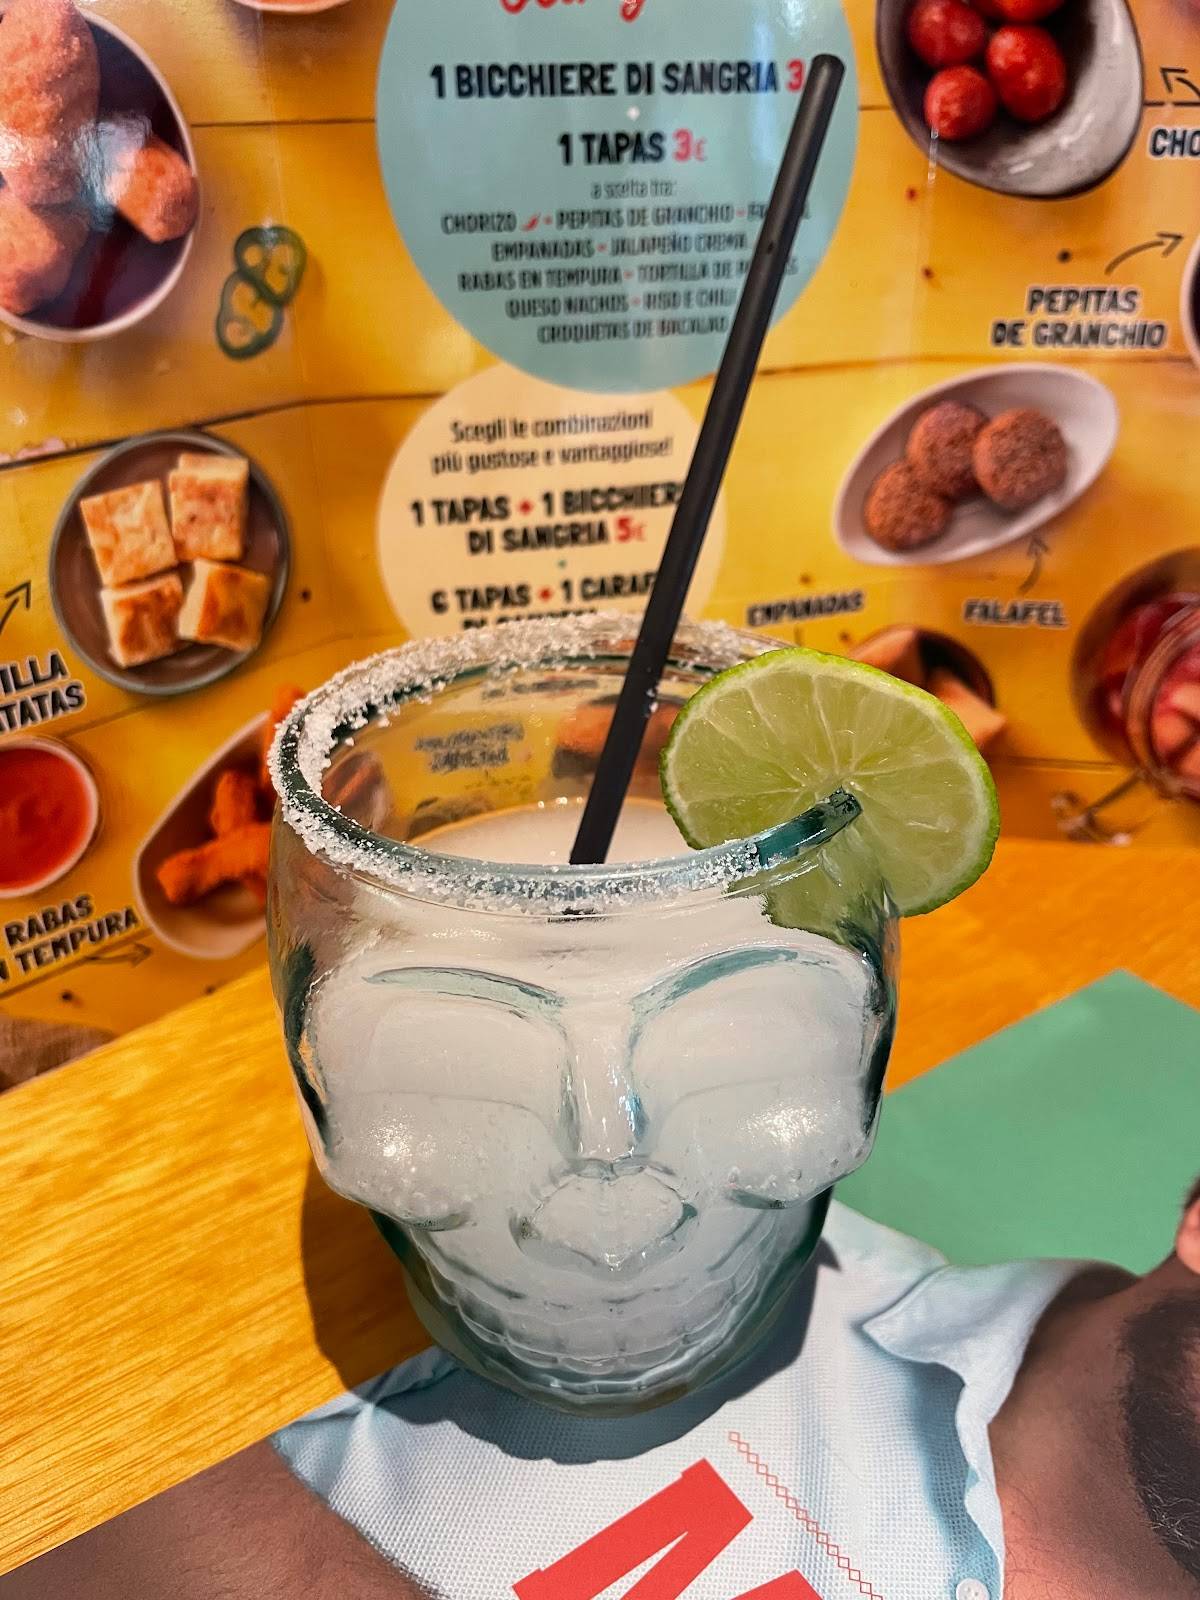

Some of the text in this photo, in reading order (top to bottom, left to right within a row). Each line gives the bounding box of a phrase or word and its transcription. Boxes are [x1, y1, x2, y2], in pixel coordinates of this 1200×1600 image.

[430, 59, 806, 98] 1 BICCHIERE DI SANGRIA 3
[558, 133, 573, 165] 1
[580, 131, 665, 164] TAPAS
[441, 210, 517, 235] CHORIZO
[556, 207, 624, 231] PEPITAS
[627, 207, 648, 228] DE
[491, 239, 595, 262] EMPANADAS
[457, 270, 516, 293] RABAS
[519, 268, 543, 290] EN
[545, 267, 623, 289] TEMPURA
[505, 297, 561, 320] QUESO
[563, 294, 630, 315] NACHOS
[1027, 288, 1139, 314] PEPITAS
[537, 321, 630, 344] CROQUETAS
[993, 322, 1166, 348] DE GRANCHIO
[451, 409, 653, 444] Scegli le combinazioni
[431, 451, 462, 475] più
[467, 448, 540, 475] gustose
[543, 451, 554, 466] e
[411, 481, 682, 526] 1 TAPAS 1 BICCHIER
[468, 529, 493, 556] DI
[501, 520, 609, 552] SANGRIA
[455, 585, 532, 612] TAPAS
[561, 579, 573, 601] 1
[580, 571, 658, 600] CARAF
[747, 591, 863, 626] EMPANADAS
[964, 600, 1066, 627] FALAFEL
[5, 895, 93, 947] RABAS
[14, 906, 139, 974] TEMPURA
